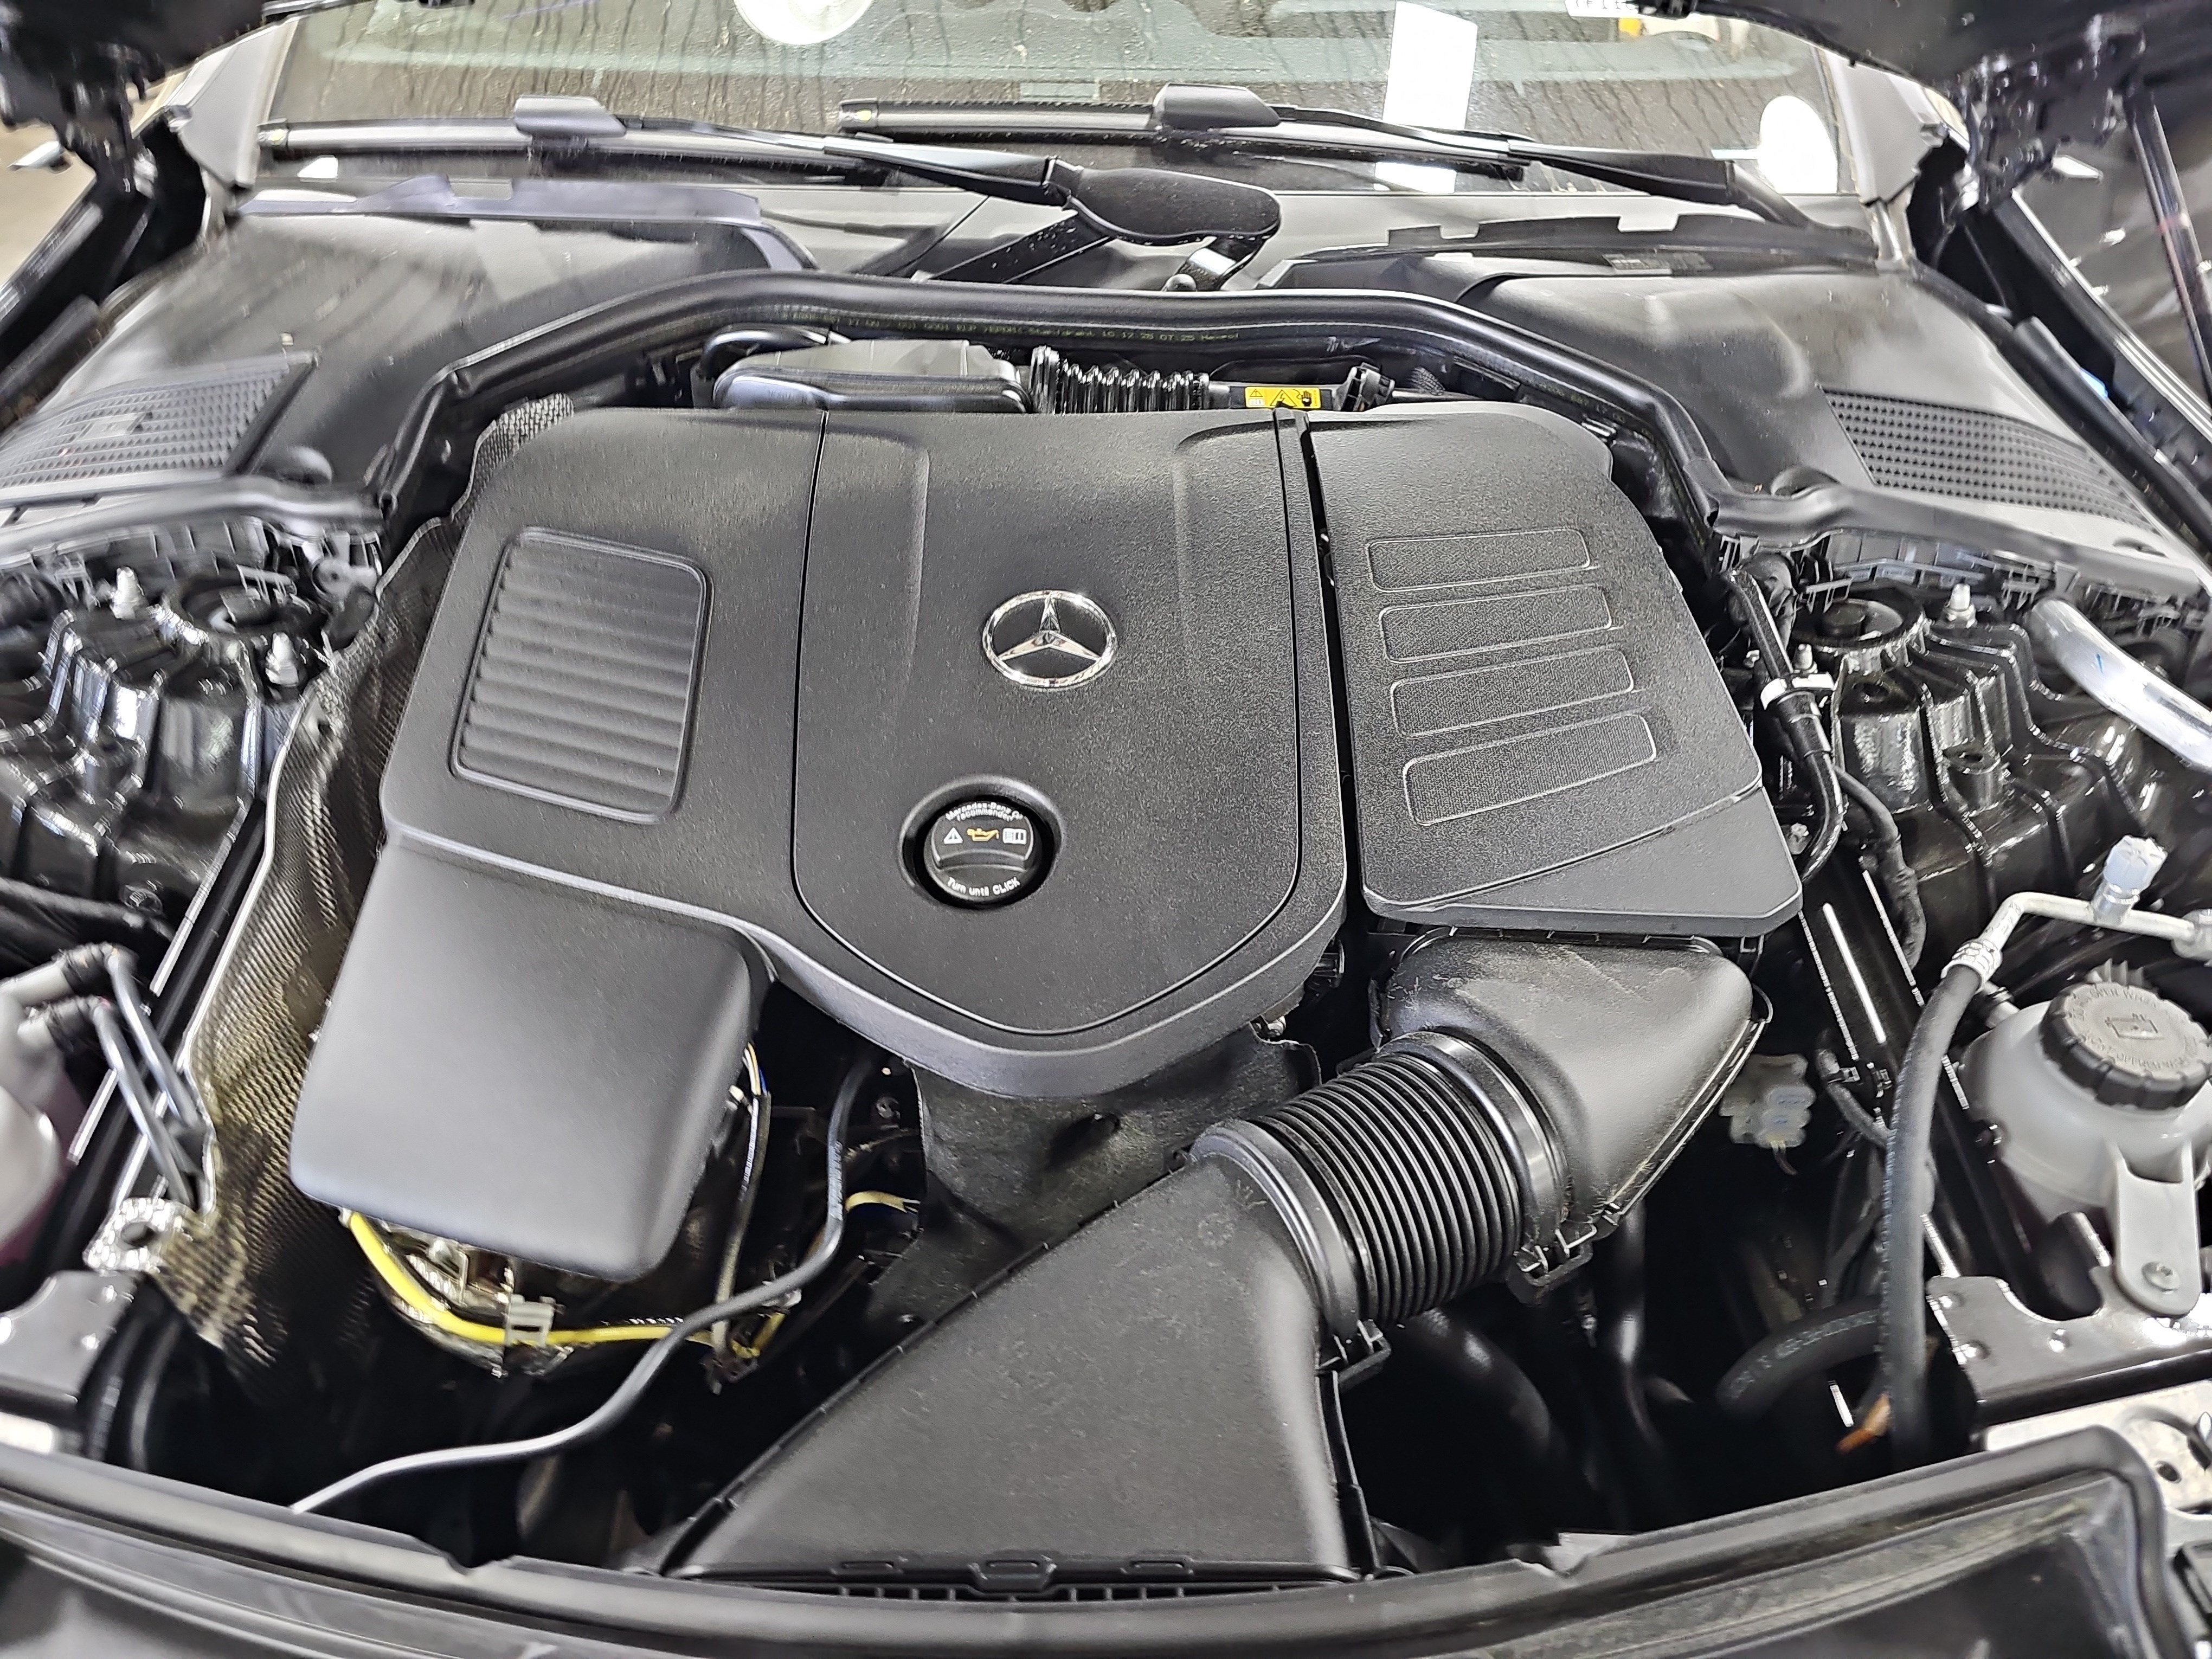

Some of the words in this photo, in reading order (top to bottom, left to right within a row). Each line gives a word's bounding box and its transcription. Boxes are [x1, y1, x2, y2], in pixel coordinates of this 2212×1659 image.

[947, 876, 967, 894] Turn
[968, 886, 989, 897] until
[992, 876, 1021, 896] CLICK
